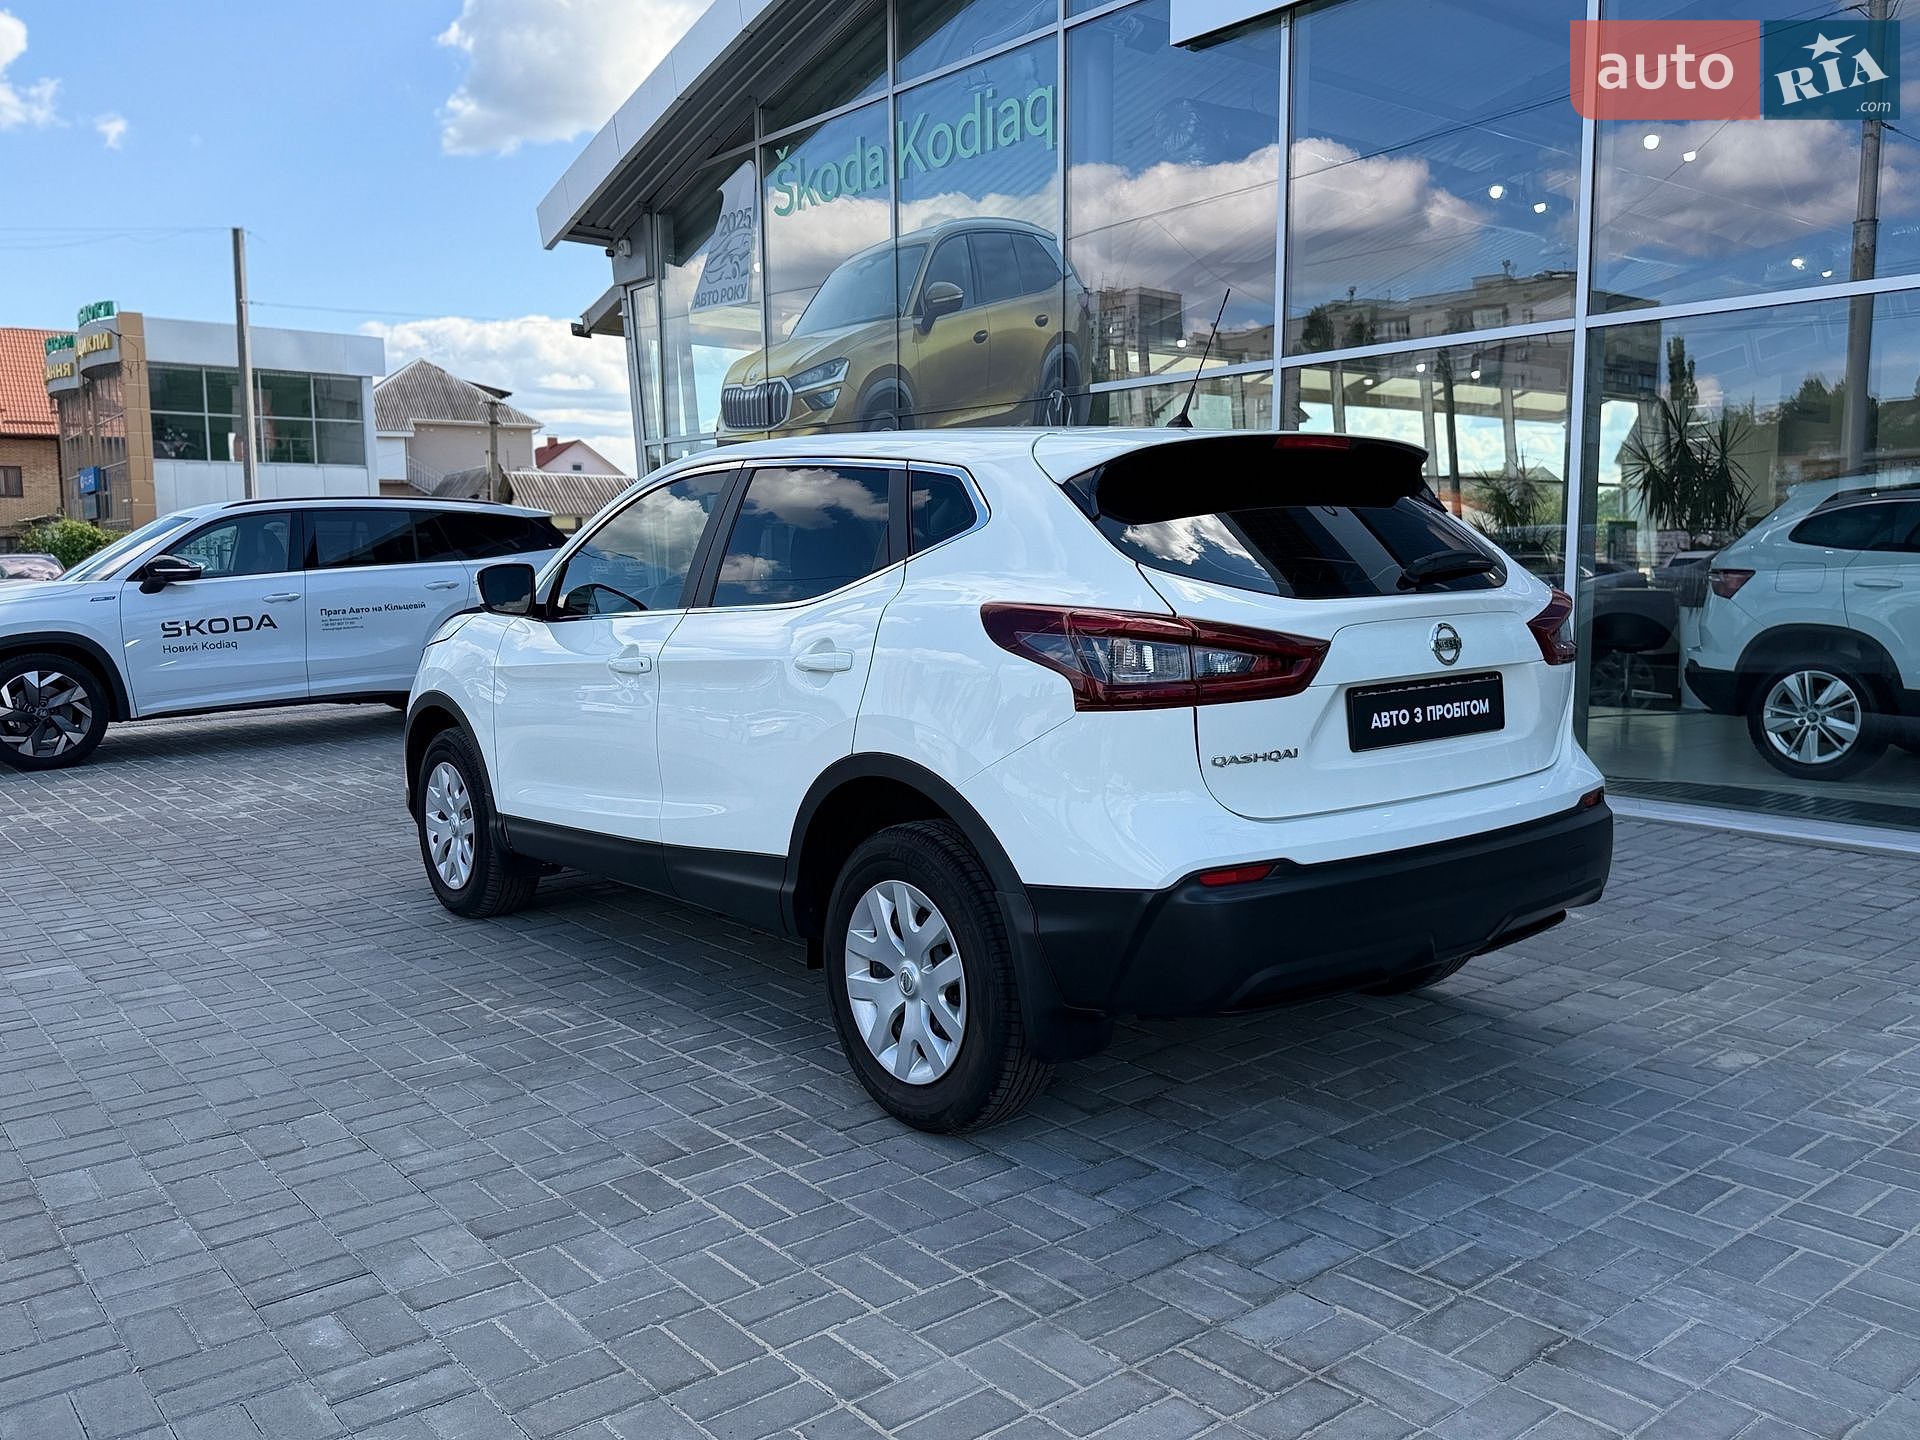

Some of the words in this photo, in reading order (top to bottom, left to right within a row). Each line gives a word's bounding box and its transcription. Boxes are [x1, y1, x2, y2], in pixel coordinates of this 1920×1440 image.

[772, 135, 888, 218] Škoda
[897, 84, 1059, 180] Kodiaq
[719, 206, 753, 237] 2025
[694, 288, 719, 309] АВТО
[720, 282, 748, 304] РОКУ
[320, 608, 347, 617] Прага
[348, 606, 370, 615] Авто
[372, 605, 383, 613] на
[162, 641, 199, 655] Новий
[201, 639, 238, 652] Kodiaq
[1370, 708, 1410, 730] АВТО
[1426, 698, 1490, 722] ПРОБІГОМ
[1210, 747, 1299, 768] QASHQAI
